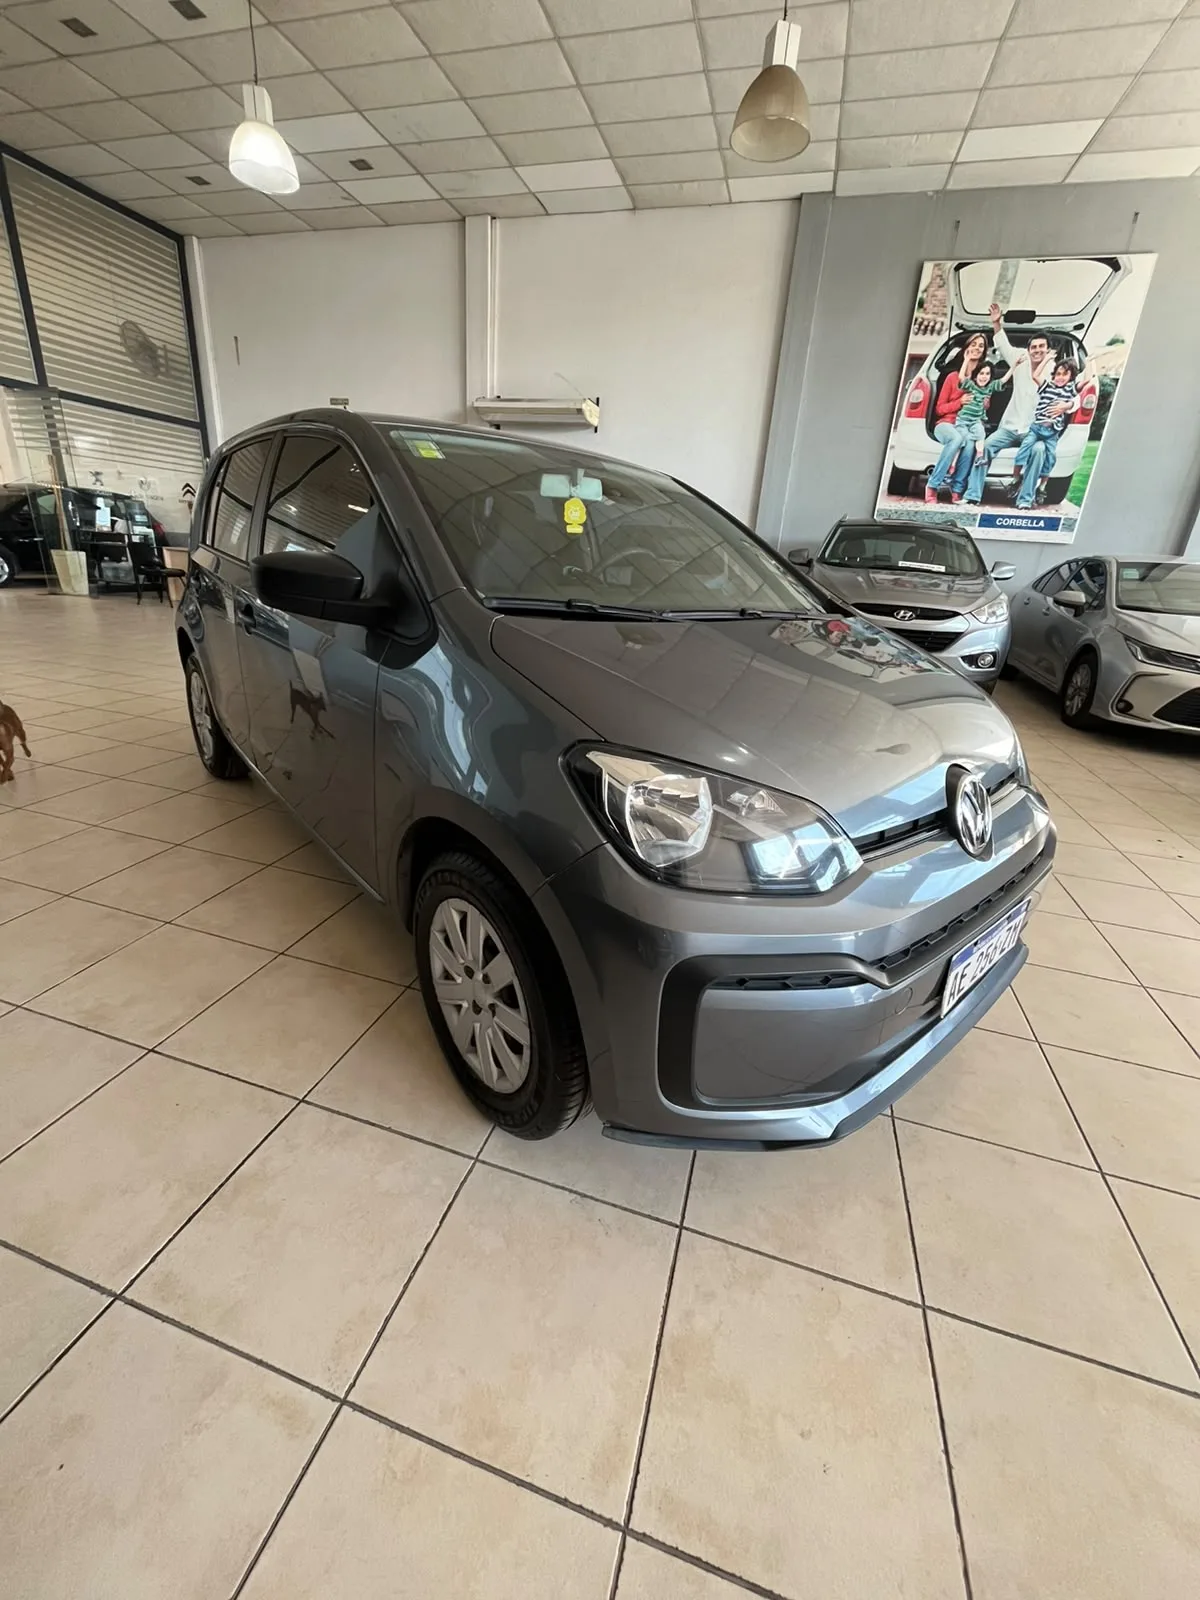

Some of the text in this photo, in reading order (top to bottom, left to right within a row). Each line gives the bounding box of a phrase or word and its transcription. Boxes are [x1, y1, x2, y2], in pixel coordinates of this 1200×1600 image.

[995, 517, 1045, 528] CORBELLA
[946, 962, 972, 1007] AE
[970, 935, 1001, 983] 256
